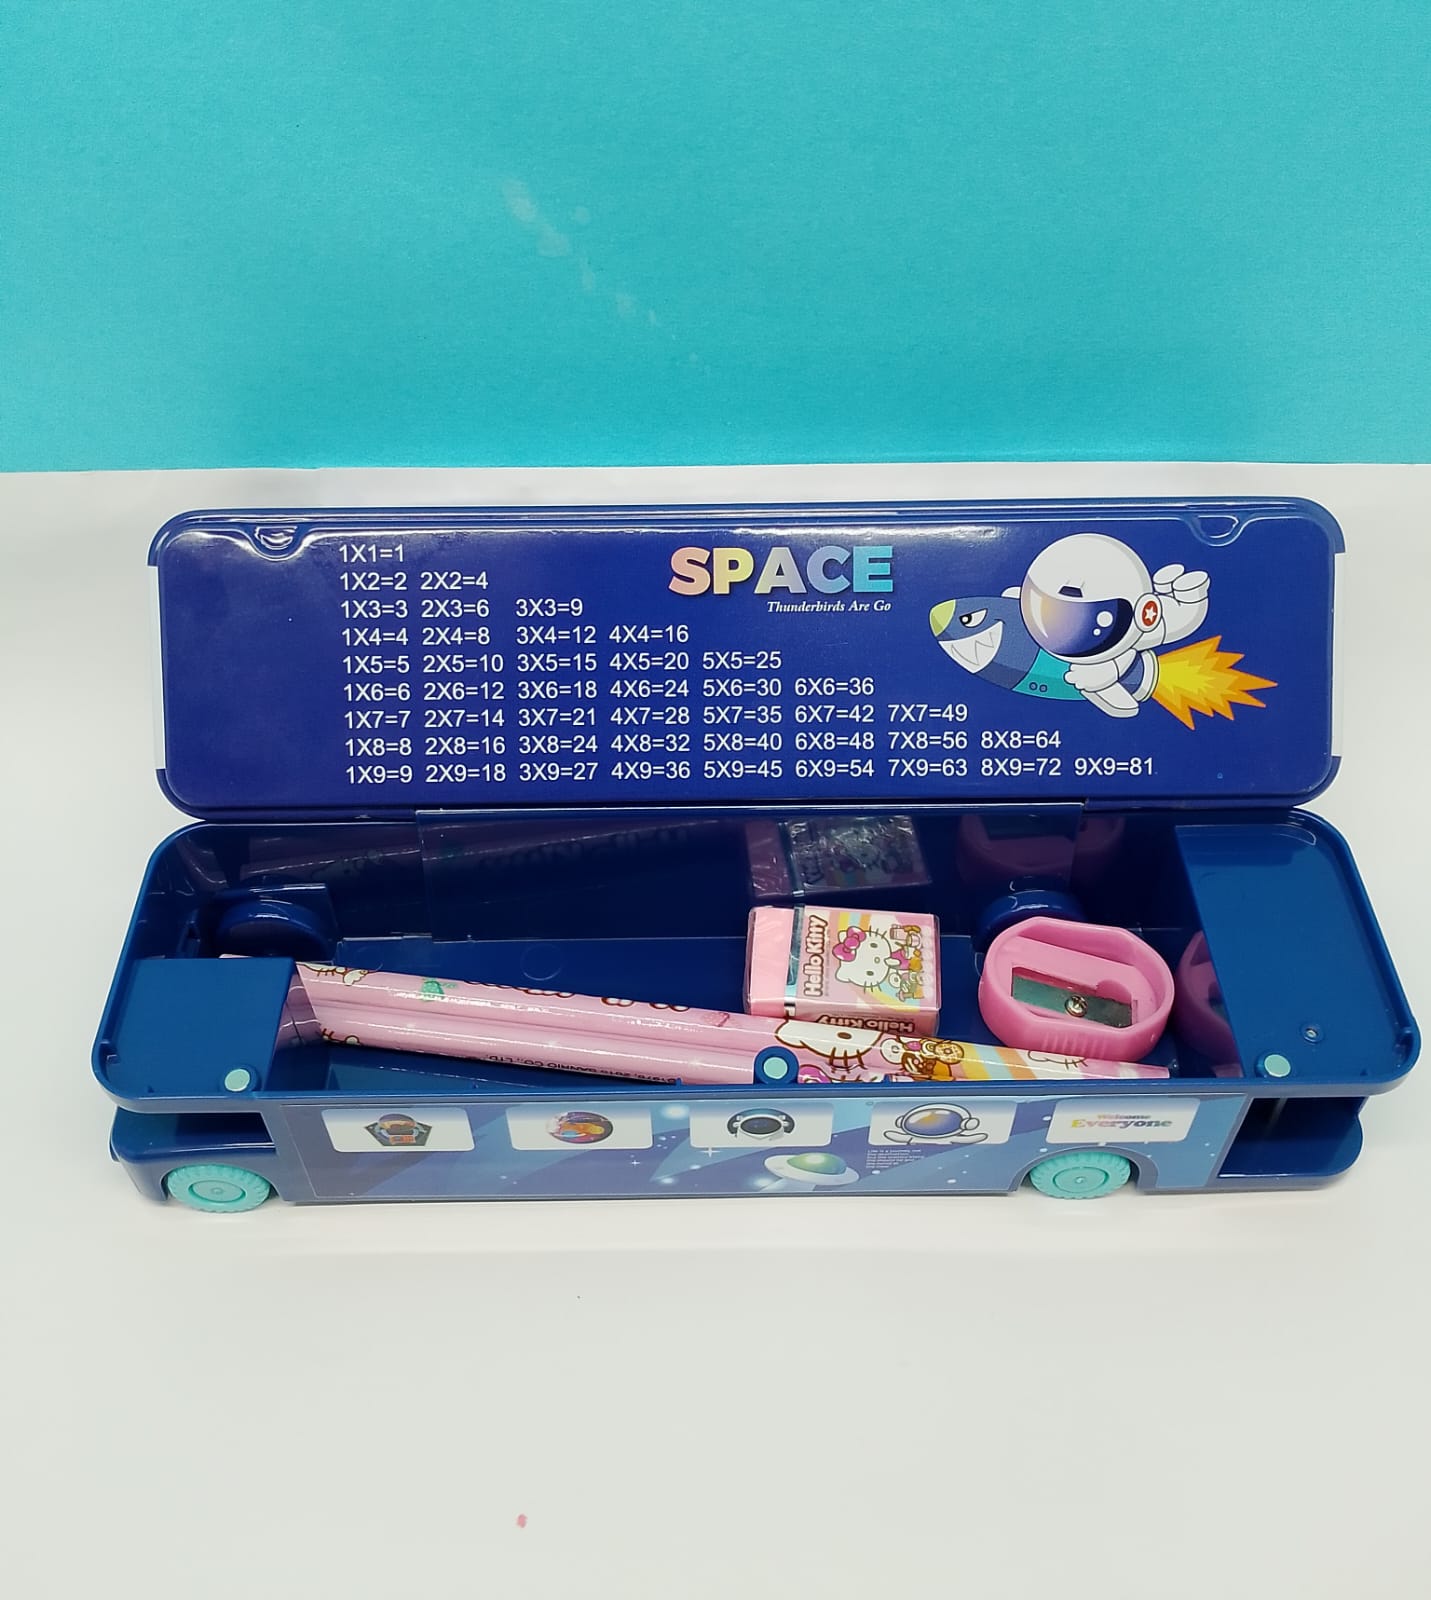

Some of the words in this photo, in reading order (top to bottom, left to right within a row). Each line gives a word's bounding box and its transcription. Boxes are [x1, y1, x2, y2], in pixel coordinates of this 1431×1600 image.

[338, 543, 405, 563] 1X1=1
[339, 571, 408, 591] 1X2=2
[420, 571, 489, 590] 2X2=4
[668, 545, 894, 596] SPACE
[340, 599, 408, 619] 1X3=3
[421, 598, 490, 618] 2X3=6
[515, 598, 583, 617] 3X3=9
[767, 601, 845, 613] Thunderbirds
[848, 601, 869, 612] Are
[873, 600, 892, 612] Go
[341, 627, 409, 647] 1X4=4
[422, 626, 491, 646] 2X4=8
[516, 625, 597, 645] 3X4=12
[608, 624, 689, 644] 4X4=16
[342, 655, 410, 674] 1X5=5
[422, 653, 504, 673] 2X5=10
[517, 652, 597, 672] 3X5=15
[609, 651, 689, 671] 4X5=20
[702, 650, 782, 670] 5X5=25
[343, 682, 411, 702] 1X6=6
[423, 681, 505, 701] 2X6=12
[518, 680, 598, 700] 3X6=18
[609, 679, 690, 698] 4X6=24
[702, 678, 782, 697] 5X6=30
[794, 676, 875, 696] 6X6=36
[344, 710, 411, 729] 1X7=7
[424, 708, 505, 728] 2X7=14
[518, 707, 595, 727] 3X7=21
[610, 706, 690, 725] 4X7=28
[703, 705, 782, 724] 5X7=35
[794, 704, 875, 724] 6X7=42
[887, 703, 968, 722] 7X7=49
[345, 737, 412, 757] 1X8=8
[424, 736, 506, 756] 2X8=16
[519, 734, 598, 754] 3X8=24
[610, 733, 691, 753] 4X8=32
[703, 732, 783, 752] 5X8=40
[795, 731, 875, 751] 6X8=48
[887, 730, 968, 750] 7X8=56
[980, 730, 1062, 749] 8X8=64
[345, 764, 413, 784] 1X9=9
[425, 763, 506, 783] 2X9=18
[519, 762, 599, 781] 3X9=27
[611, 760, 691, 780] 4X9=36
[703, 759, 783, 779] 5X9=45
[795, 758, 875, 778] 6X9=54
[888, 758, 968, 777] 7X9=63
[980, 757, 1062, 777] 8X9=72
[1074, 757, 1153, 776] 9X9=81
[806, 915, 828, 954] Kitty
[804, 954, 825, 997] Hello
[817, 1014, 862, 1029] Kitty
[863, 1019, 915, 1033] Hello
[1071, 1119, 1172, 1129] Everyone
